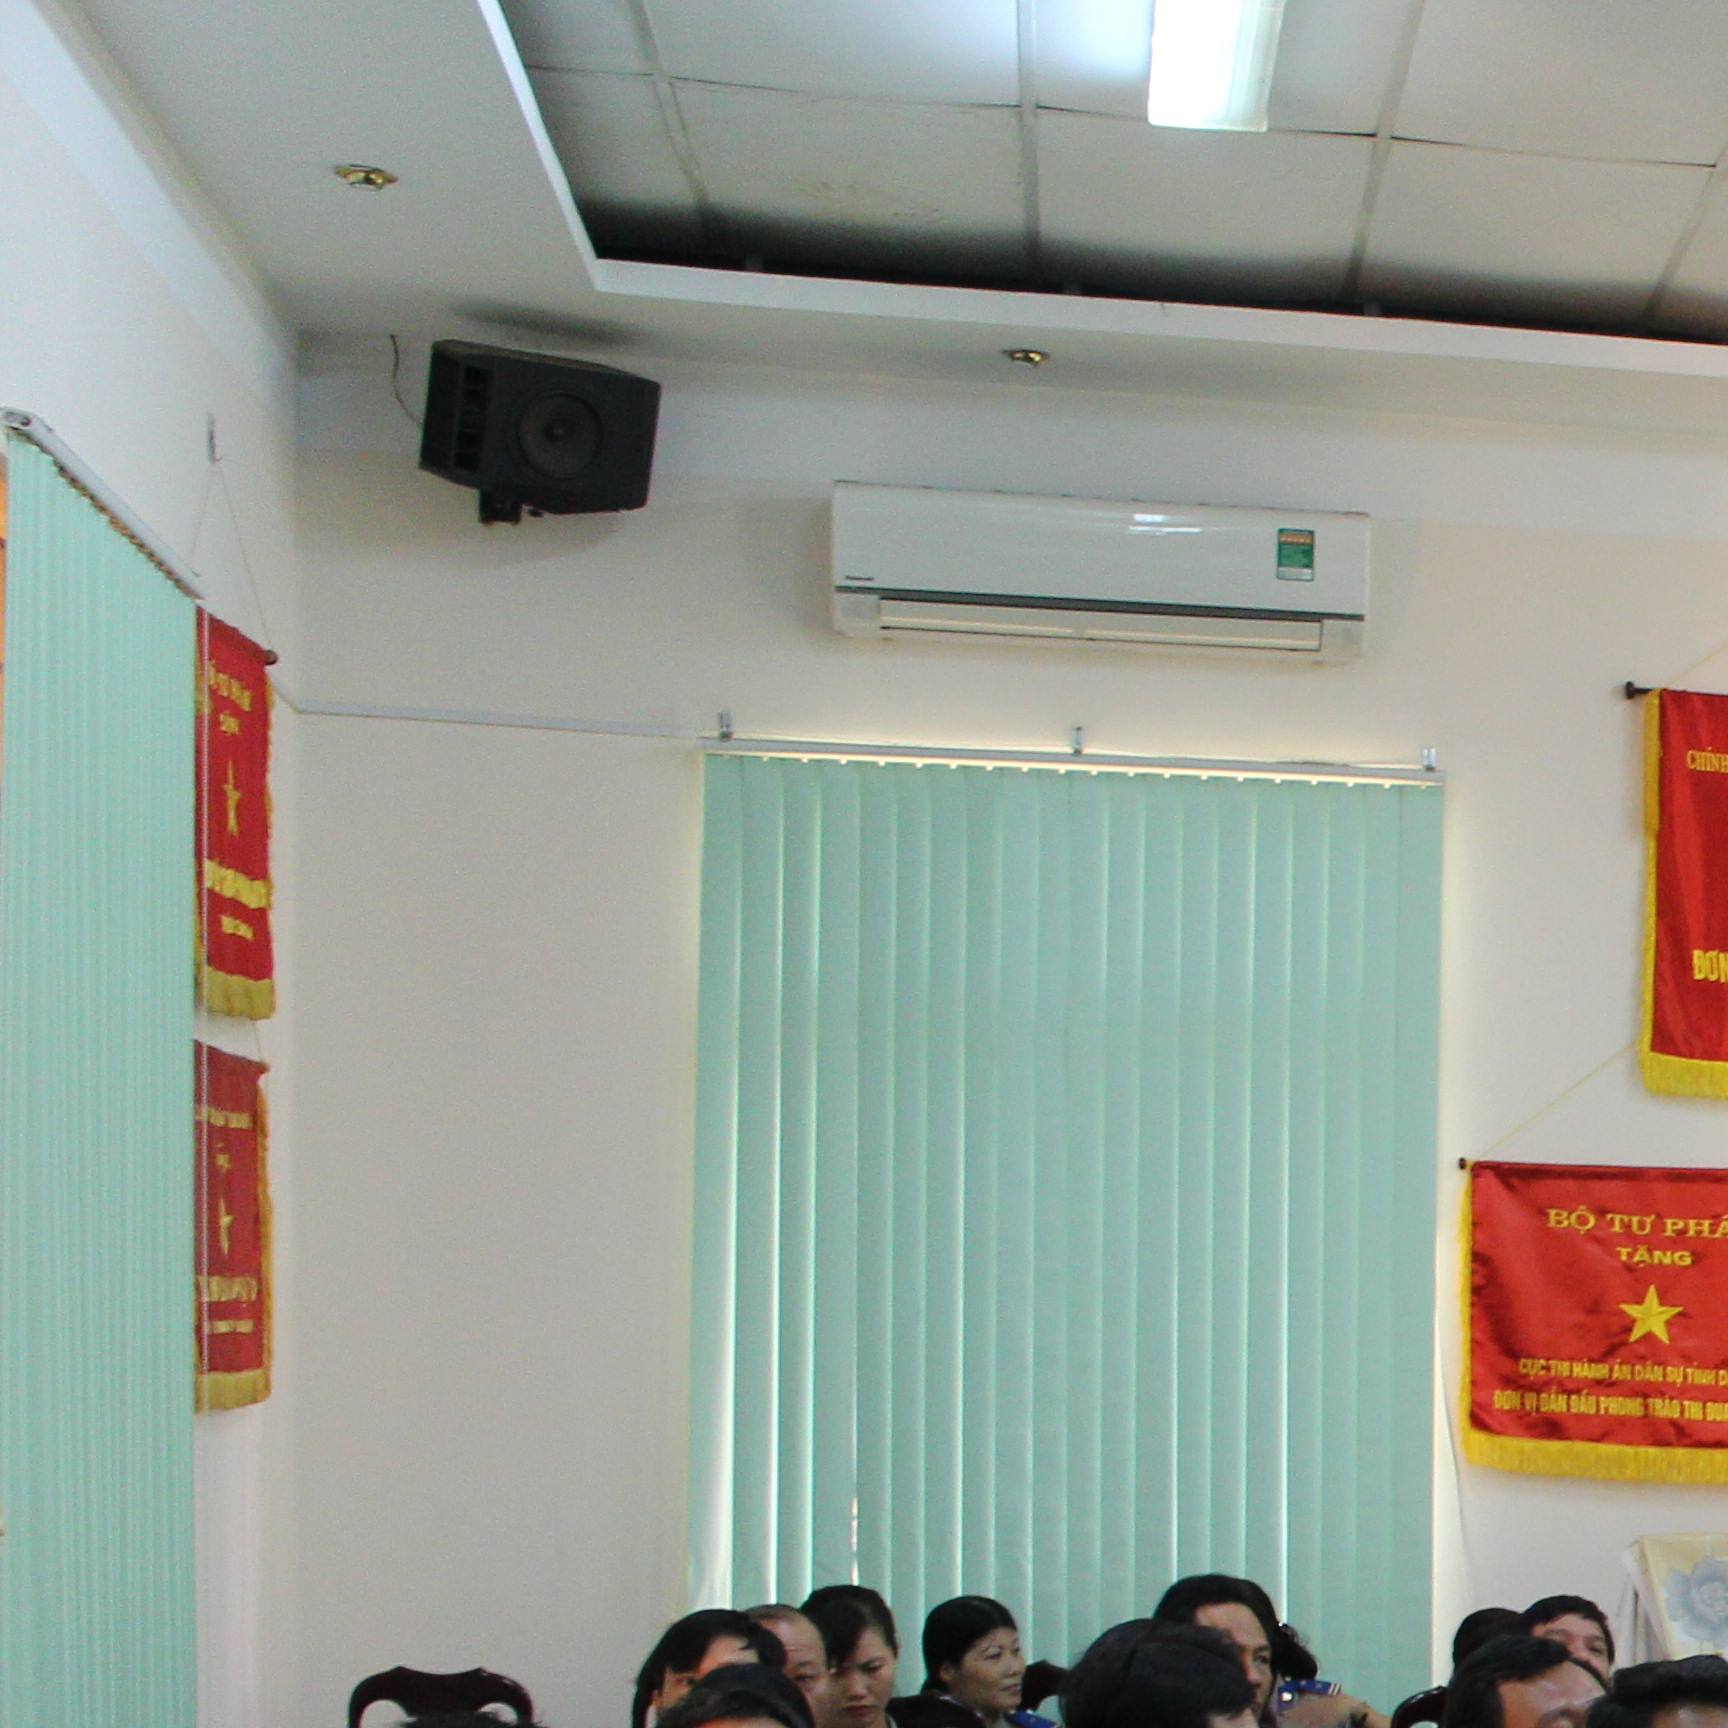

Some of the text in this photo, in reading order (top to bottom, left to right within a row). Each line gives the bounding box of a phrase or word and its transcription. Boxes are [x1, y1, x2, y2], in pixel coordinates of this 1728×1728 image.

[1546, 1205, 1597, 1234] BỘ
[1606, 1213, 1657, 1235] TƯ
[1615, 1245, 1694, 1268] TẶNG
